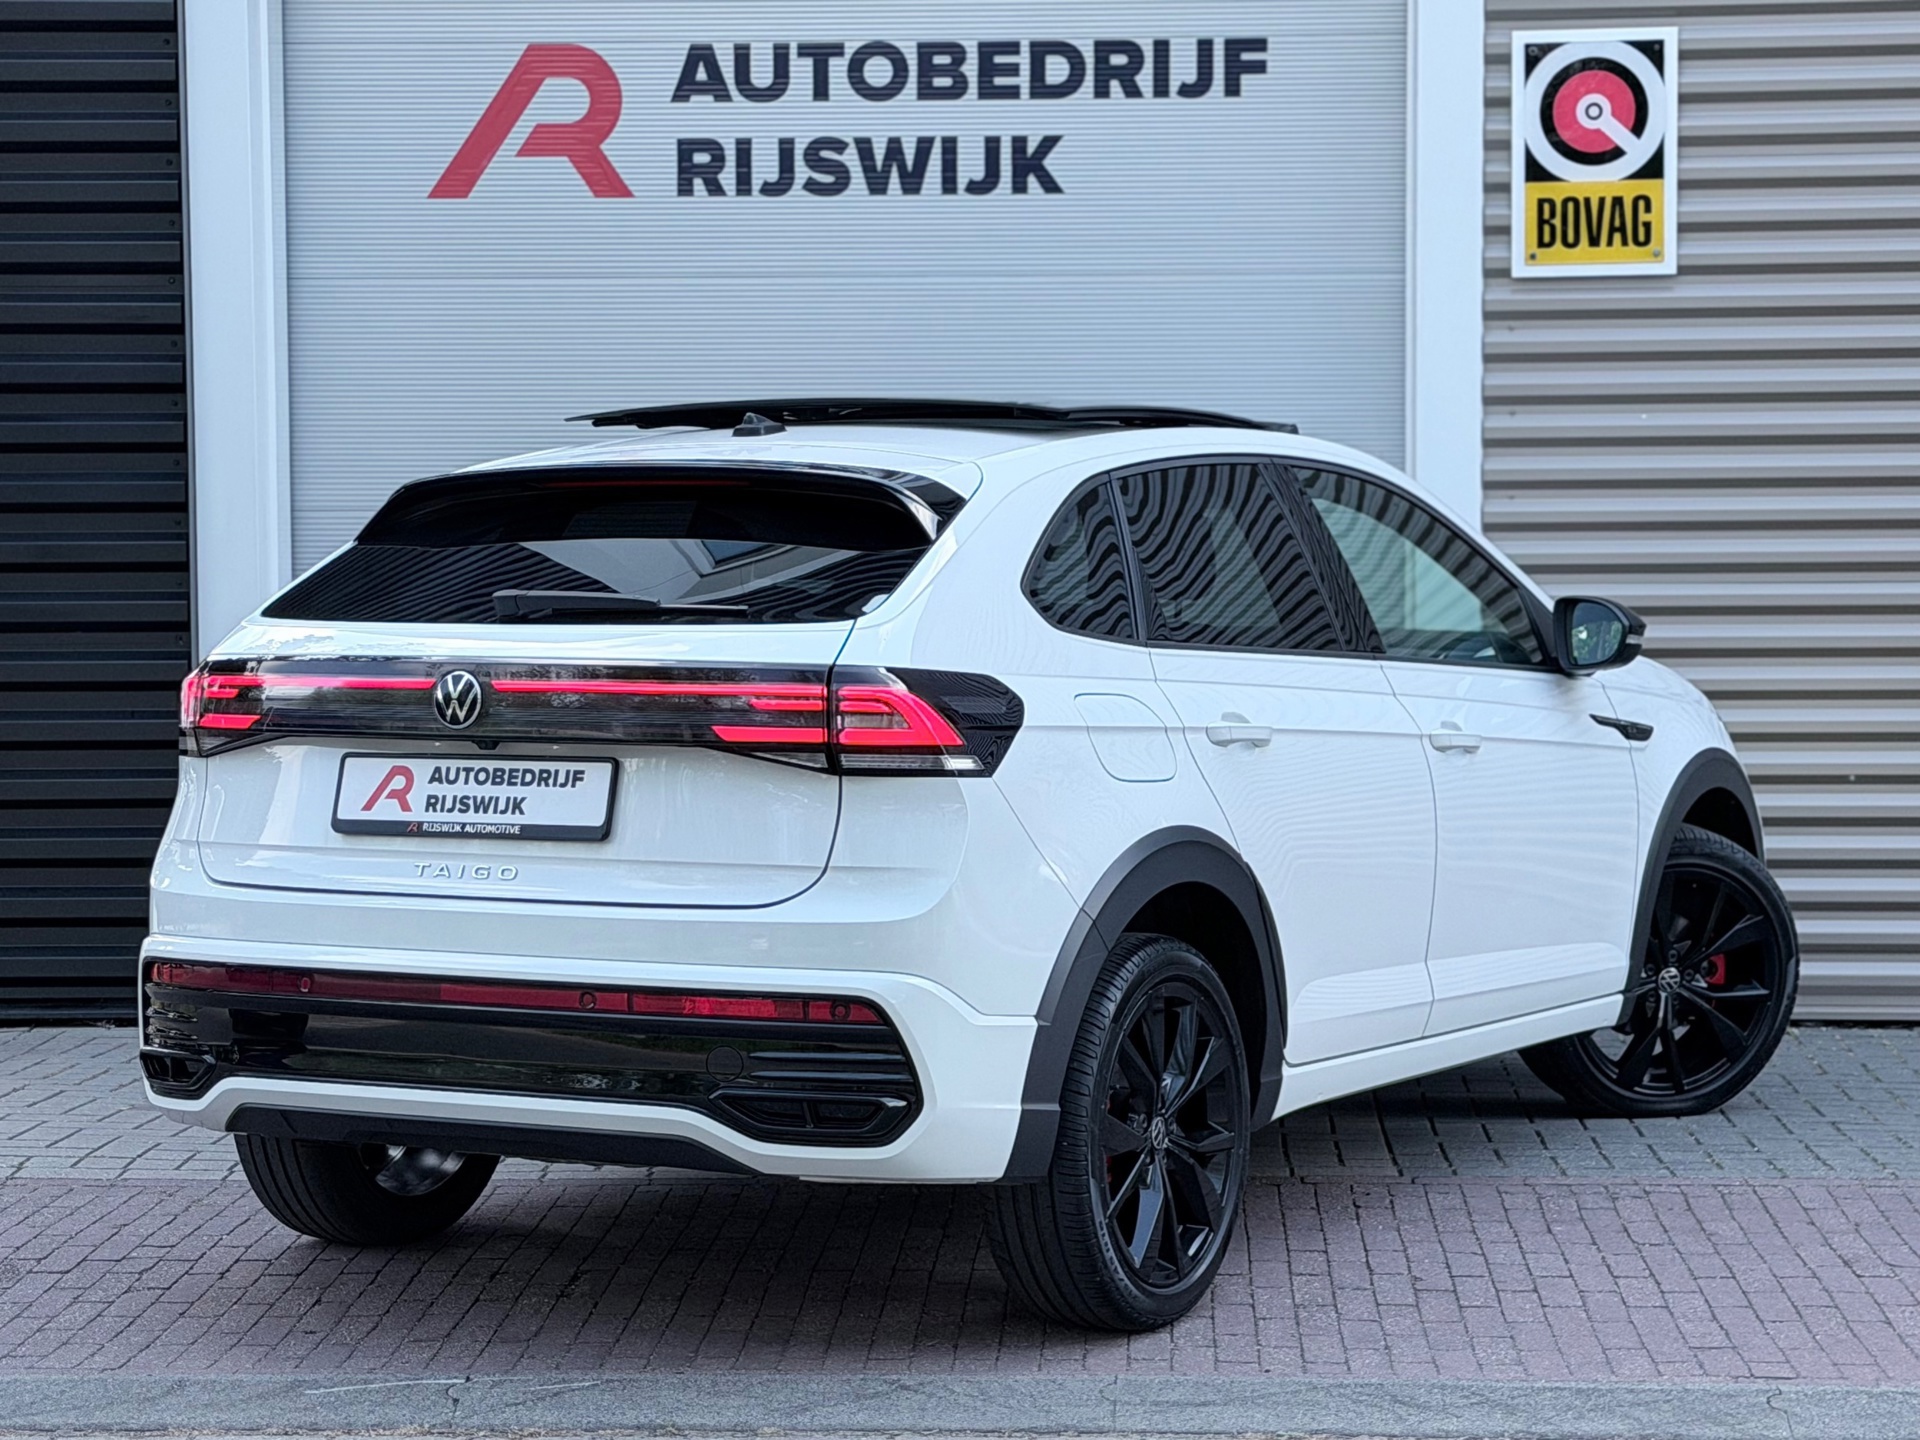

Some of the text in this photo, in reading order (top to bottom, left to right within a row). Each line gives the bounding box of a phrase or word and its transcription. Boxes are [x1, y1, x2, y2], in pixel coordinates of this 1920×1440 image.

[671, 37, 1268, 103] AUTOBEDRIJF
[676, 135, 1064, 198] RIJSWIJK
[1536, 194, 1652, 249] BOVAG
[427, 765, 586, 789] AUTOBEDRIJF
[424, 794, 528, 816] RIJSWIJK
[422, 822, 462, 833] RIJSWIJK
[464, 824, 521, 835] AUTOMOTIVE
[414, 862, 519, 881] TAIGO
